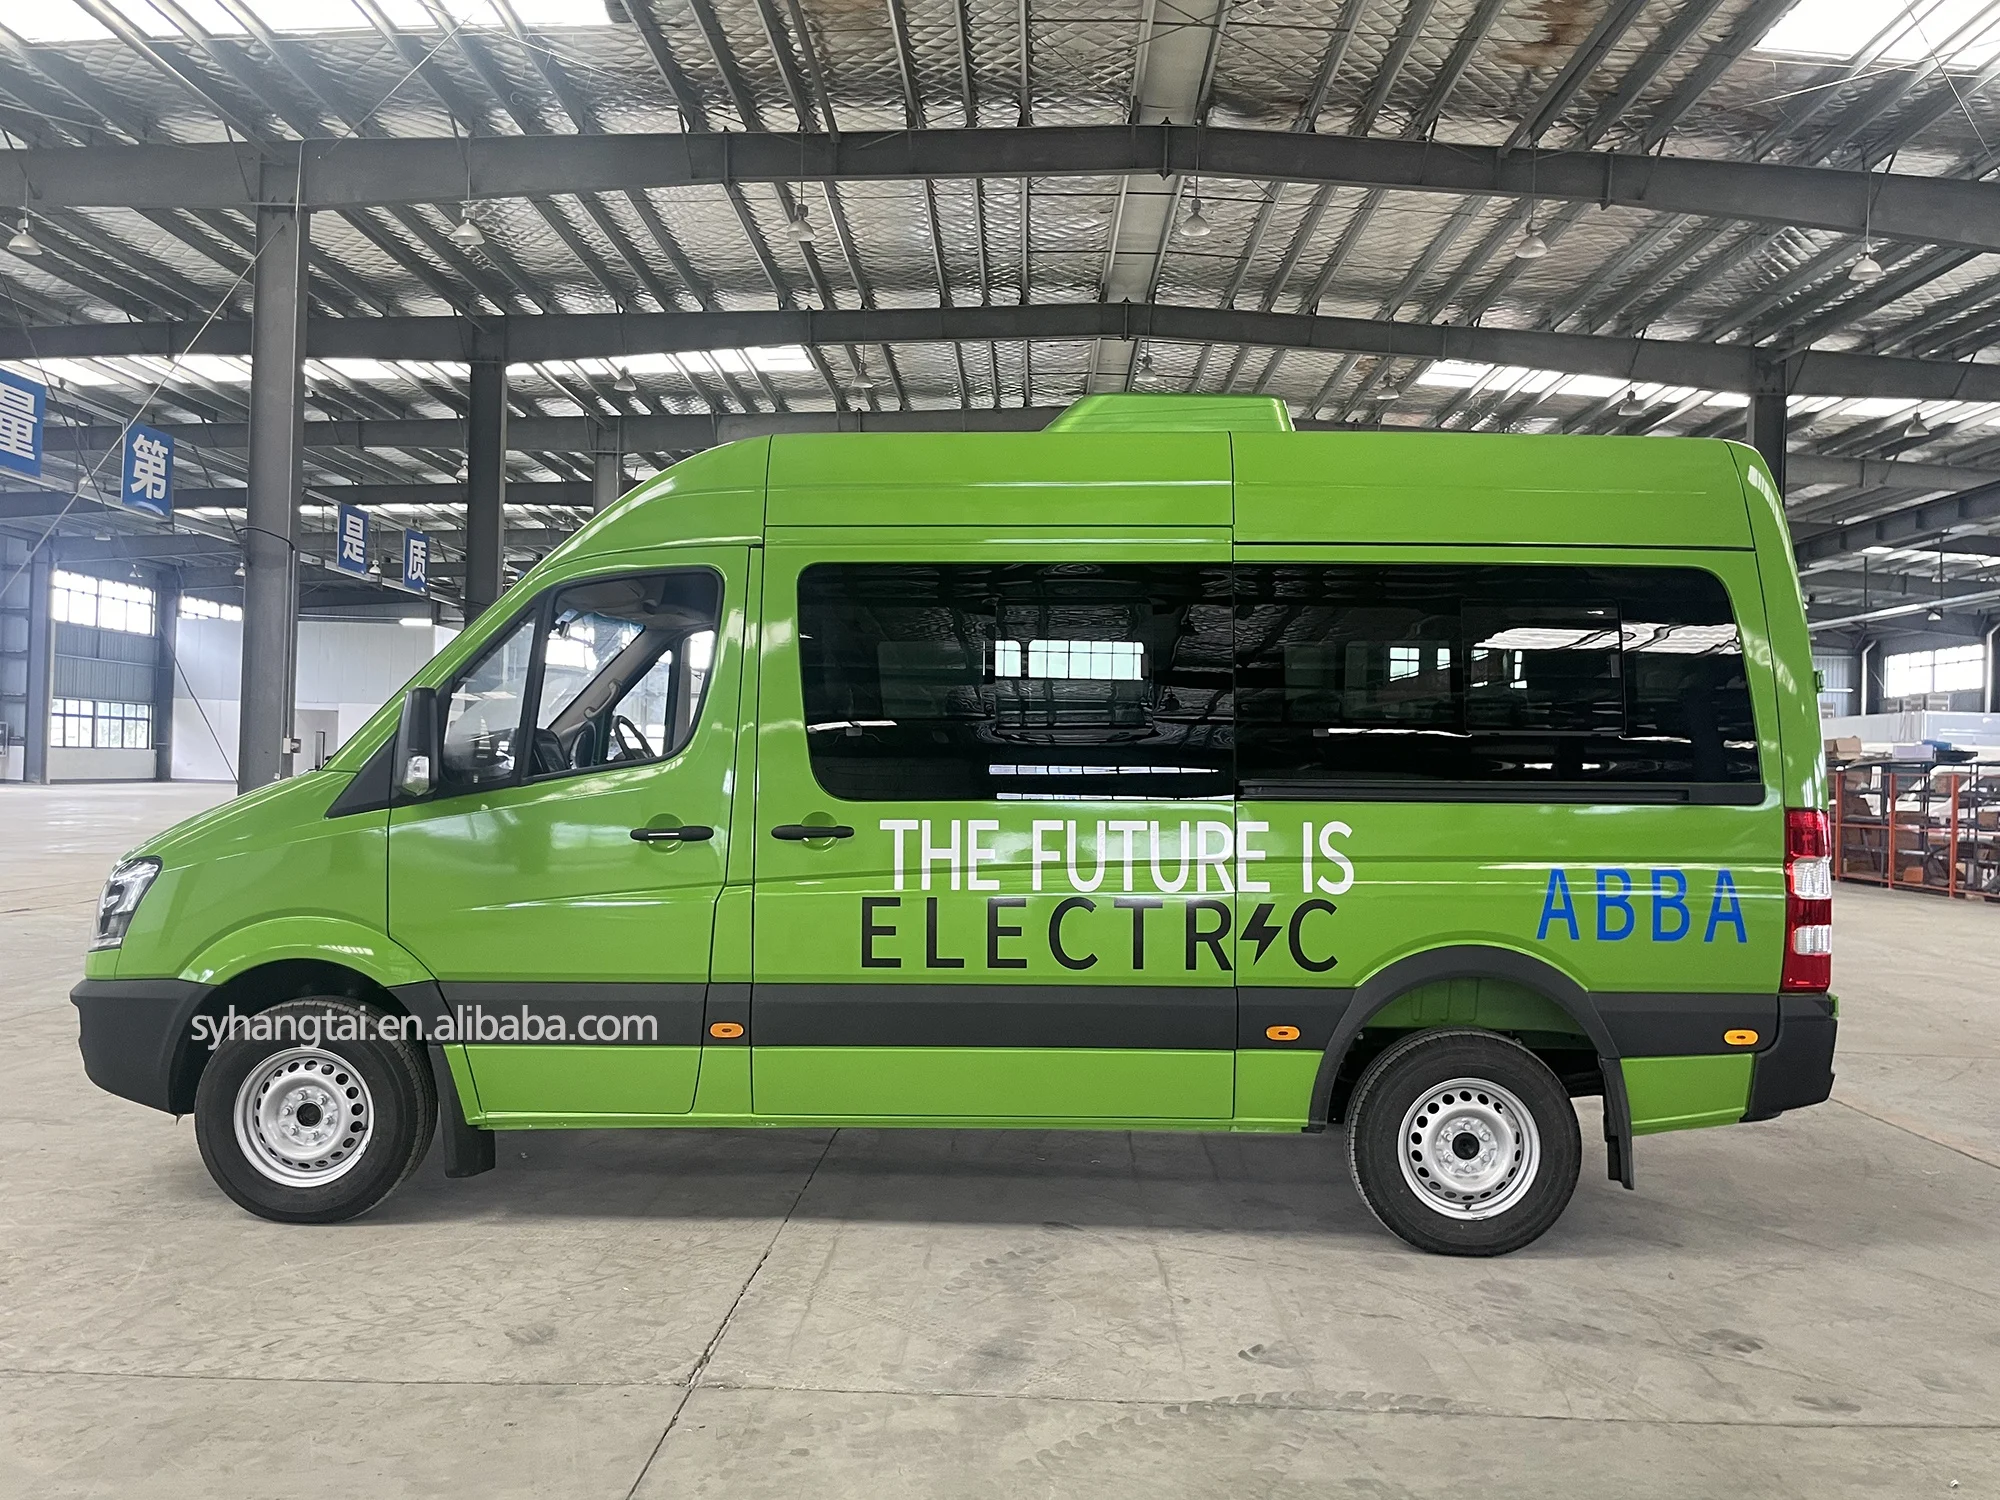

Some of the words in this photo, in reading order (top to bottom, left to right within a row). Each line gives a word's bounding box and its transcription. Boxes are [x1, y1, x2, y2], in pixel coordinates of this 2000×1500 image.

[0, 382, 38, 461] 量
[130, 434, 169, 500] 第
[343, 513, 365, 564] 是
[408, 539, 427, 583] 质
[879, 819, 1001, 892] THE
[1031, 819, 1271, 894] FUTURE
[1302, 820, 1356, 895] IS
[1536, 867, 1749, 945] ABBA
